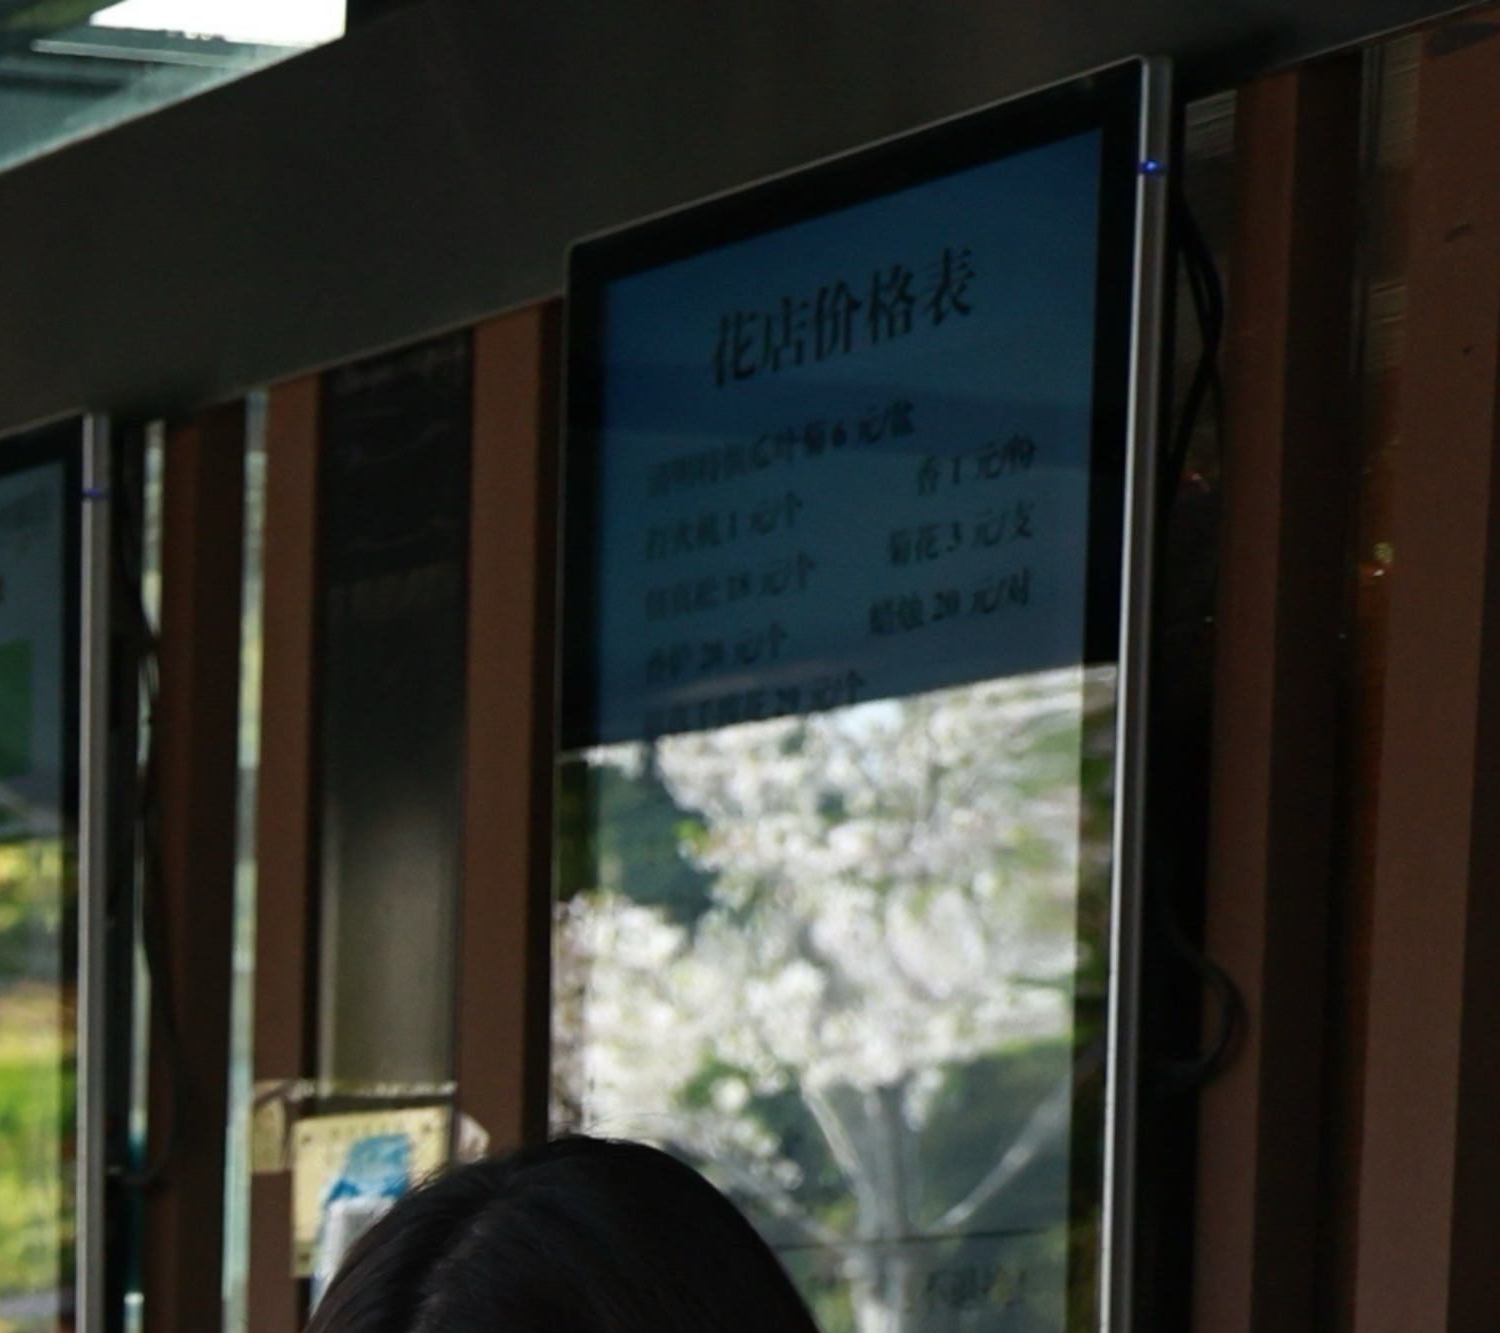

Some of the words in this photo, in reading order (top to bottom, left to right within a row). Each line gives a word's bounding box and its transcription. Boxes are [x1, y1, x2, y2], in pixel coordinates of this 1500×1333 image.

[713, 246, 976, 387] 花店价格表
